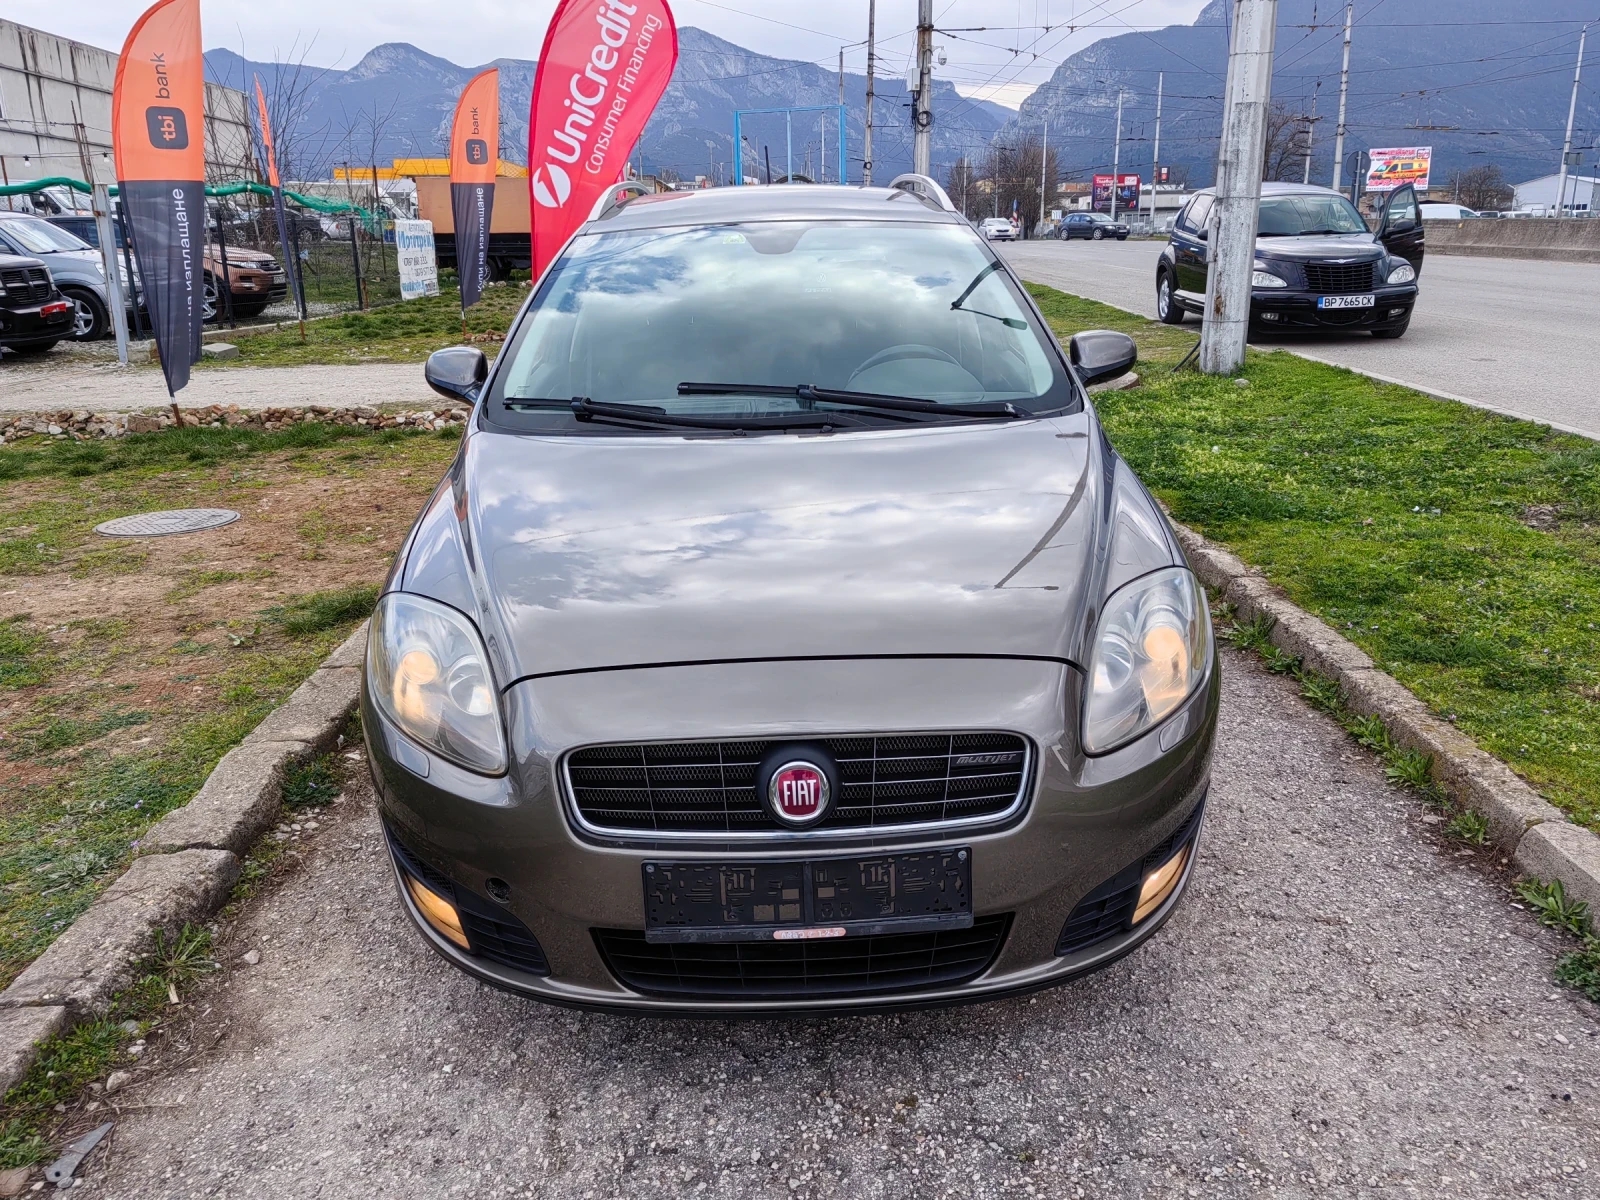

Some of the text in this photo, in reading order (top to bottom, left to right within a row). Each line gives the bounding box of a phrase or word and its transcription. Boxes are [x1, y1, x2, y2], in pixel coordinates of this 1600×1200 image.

[149, 51, 177, 142] tbi bank
[546, 0, 638, 164] UniCredit
[585, 13, 663, 175] Consumer Financing
[469, 106, 481, 160] tbi bank
[172, 188, 192, 291] изплащане
[476, 187, 486, 292] Купи на изплащане
[1324, 296, 1373, 308] BP 7665 CK
[783, 779, 817, 806] FIAT
[956, 753, 1017, 765] MULTIJET
